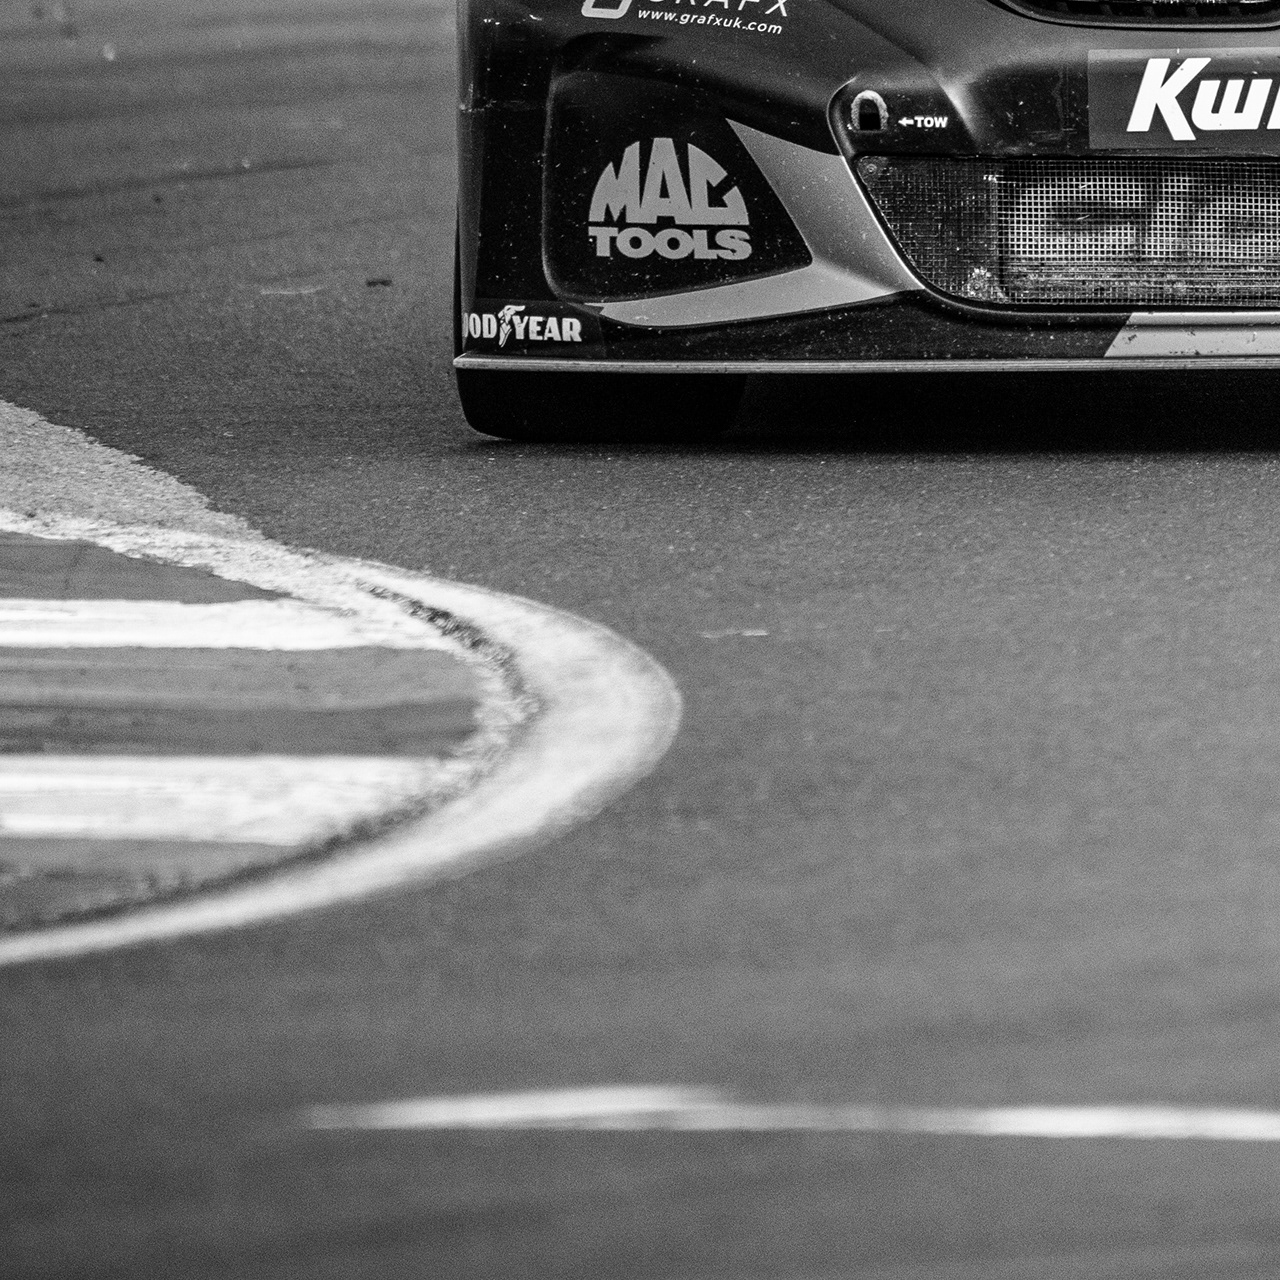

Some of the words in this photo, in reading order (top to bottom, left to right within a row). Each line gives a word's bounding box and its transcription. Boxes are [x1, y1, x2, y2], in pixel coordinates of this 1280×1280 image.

[637, 9, 783, 34] www.grafxuk.com
[914, 115, 949, 129] TOW
[588, 137, 750, 226] MAC
[588, 226, 753, 261] TOOLS
